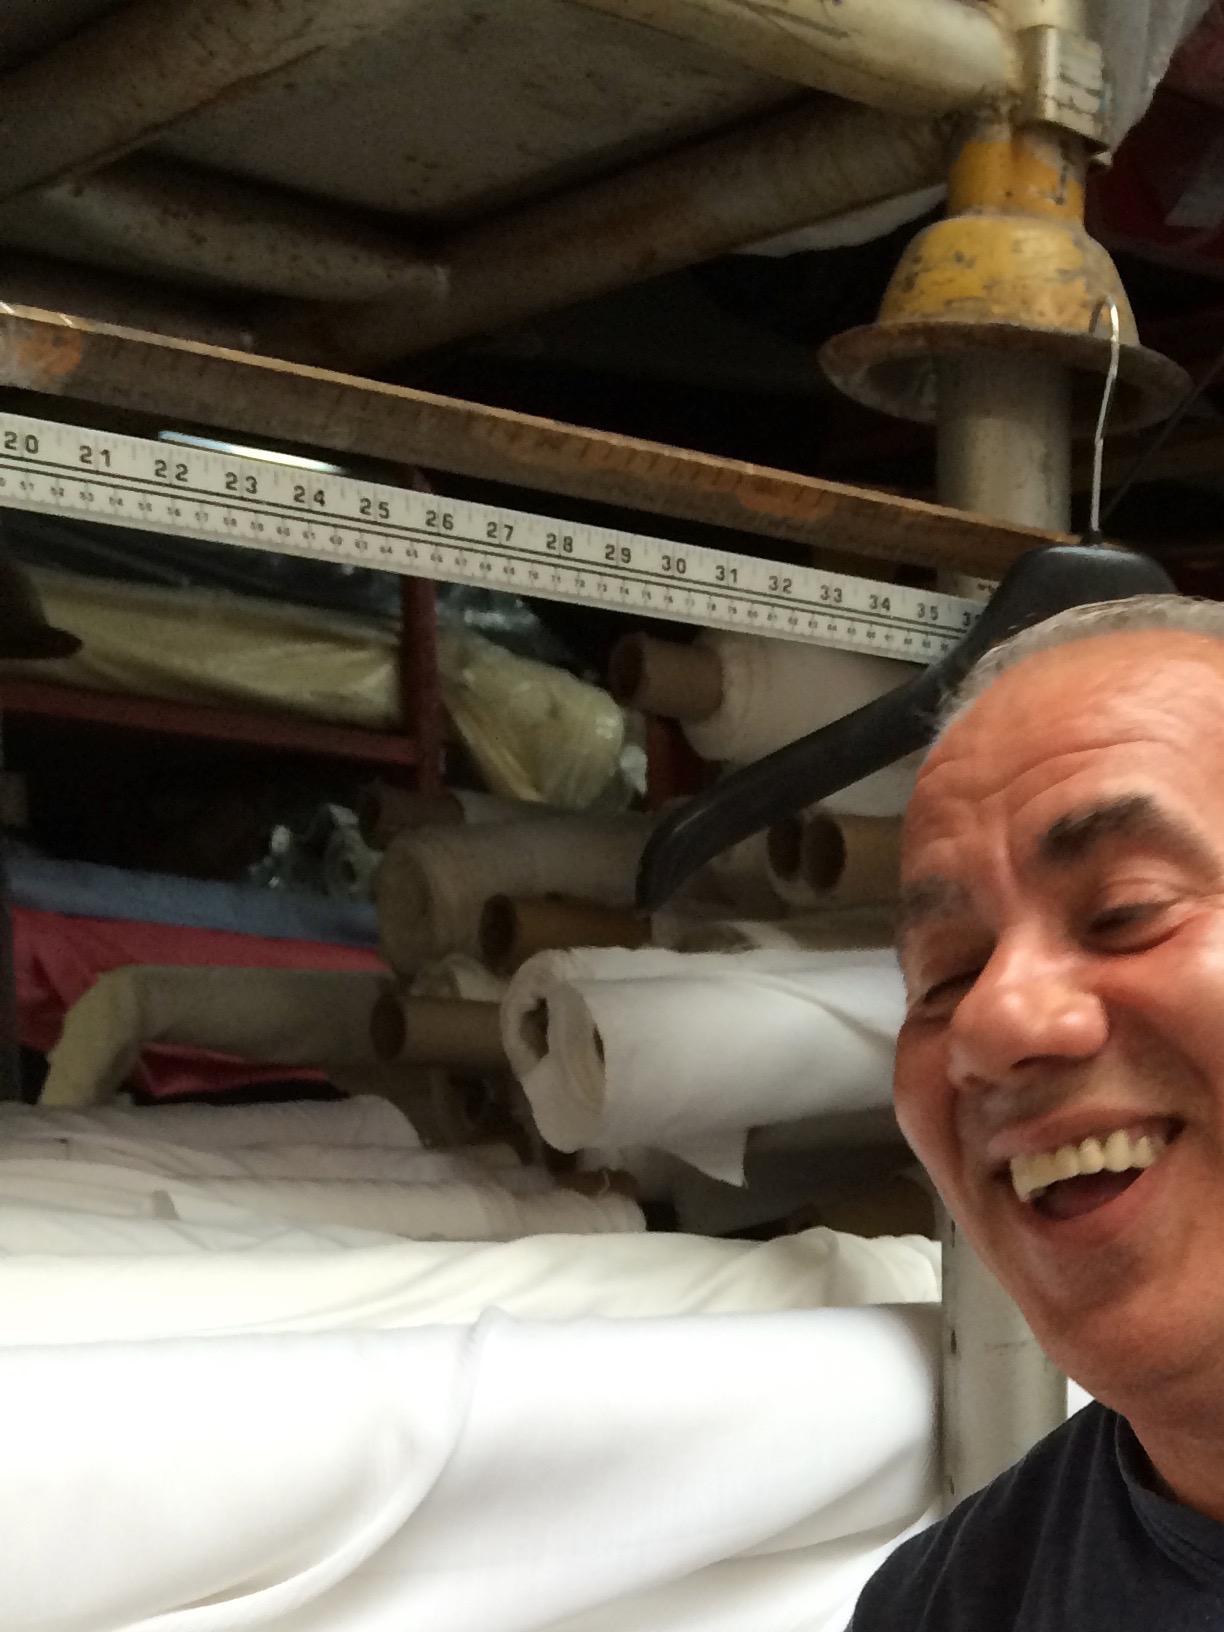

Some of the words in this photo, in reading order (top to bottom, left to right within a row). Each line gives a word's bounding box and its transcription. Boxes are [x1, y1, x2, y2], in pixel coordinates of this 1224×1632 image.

[4, 431, 39, 454] 20
[79, 445, 111, 467] 21
[155, 459, 189, 482] 22
[225, 472, 257, 494] 23
[293, 485, 326, 507] 24
[359, 498, 390, 519] 25
[425, 510, 454, 531] 26
[487, 521, 514, 542] 27
[546, 533, 573, 553] 28
[605, 544, 631, 564] 29
[662, 555, 686, 574] 30
[715, 565, 738, 583] 31
[769, 575, 793, 594] 32
[820, 584, 843, 603] 33
[870, 594, 890, 612] 34
[917, 603, 938, 620] 35
